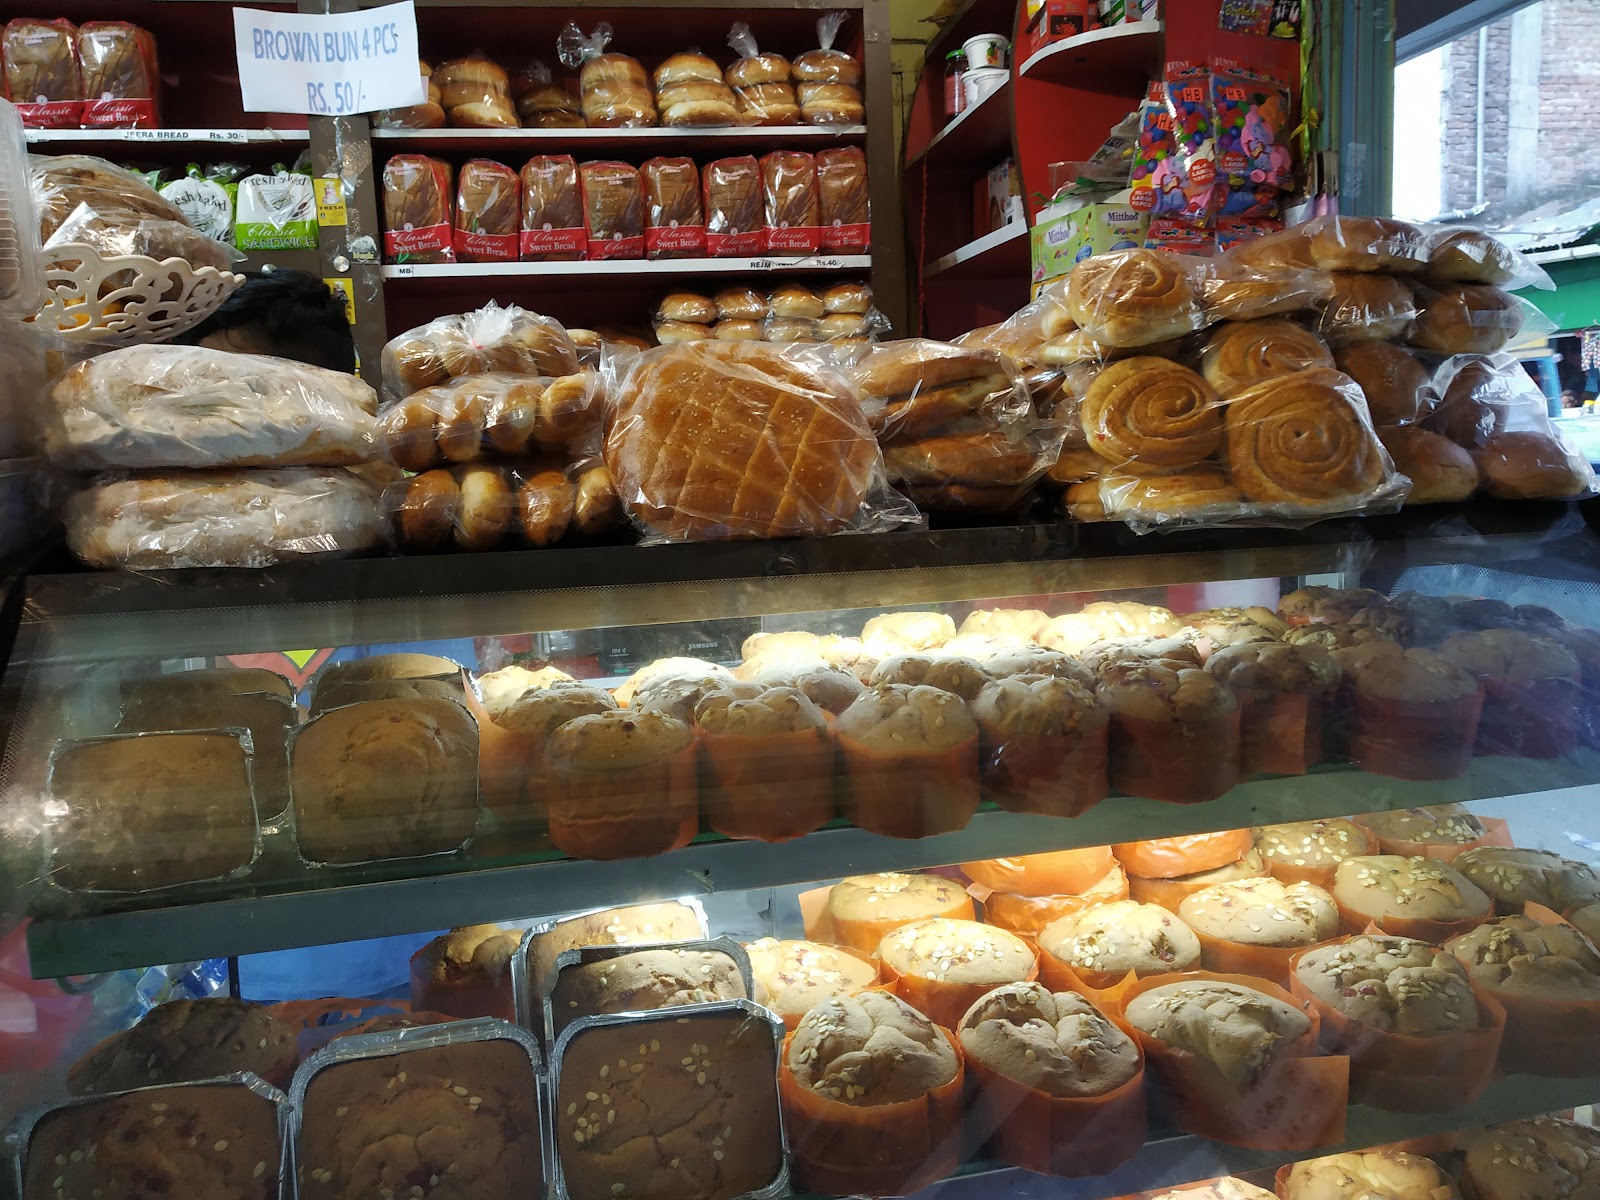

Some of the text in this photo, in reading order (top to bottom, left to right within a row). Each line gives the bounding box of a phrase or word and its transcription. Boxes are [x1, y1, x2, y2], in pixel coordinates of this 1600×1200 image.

[252, 22, 399, 63] BROWN BUN 4 PCS
[306, 81, 332, 113] RS.
[89, 113, 114, 122] Sweet
[157, 131, 189, 139] BREAD
[247, 224, 297, 237] Classic
[660, 229, 697, 238] Classic
[770, 229, 806, 239] Classic
[395, 231, 435, 243] Classic
[466, 235, 504, 247] Classic
[533, 232, 572, 242] Classic
[720, 236, 757, 246] Classic
[243, 235, 317, 250] SANDWICH
[393, 239, 441, 253] Sweet Bread
[529, 241, 576, 251] Sweet Bread
[656, 238, 700, 248] Sweet Bread
[789, 239, 810, 248] Bread
[463, 243, 508, 256] Sweet Bread
[716, 246, 737, 254] Sweet
[688, 642, 719, 650] SAMSUNG
